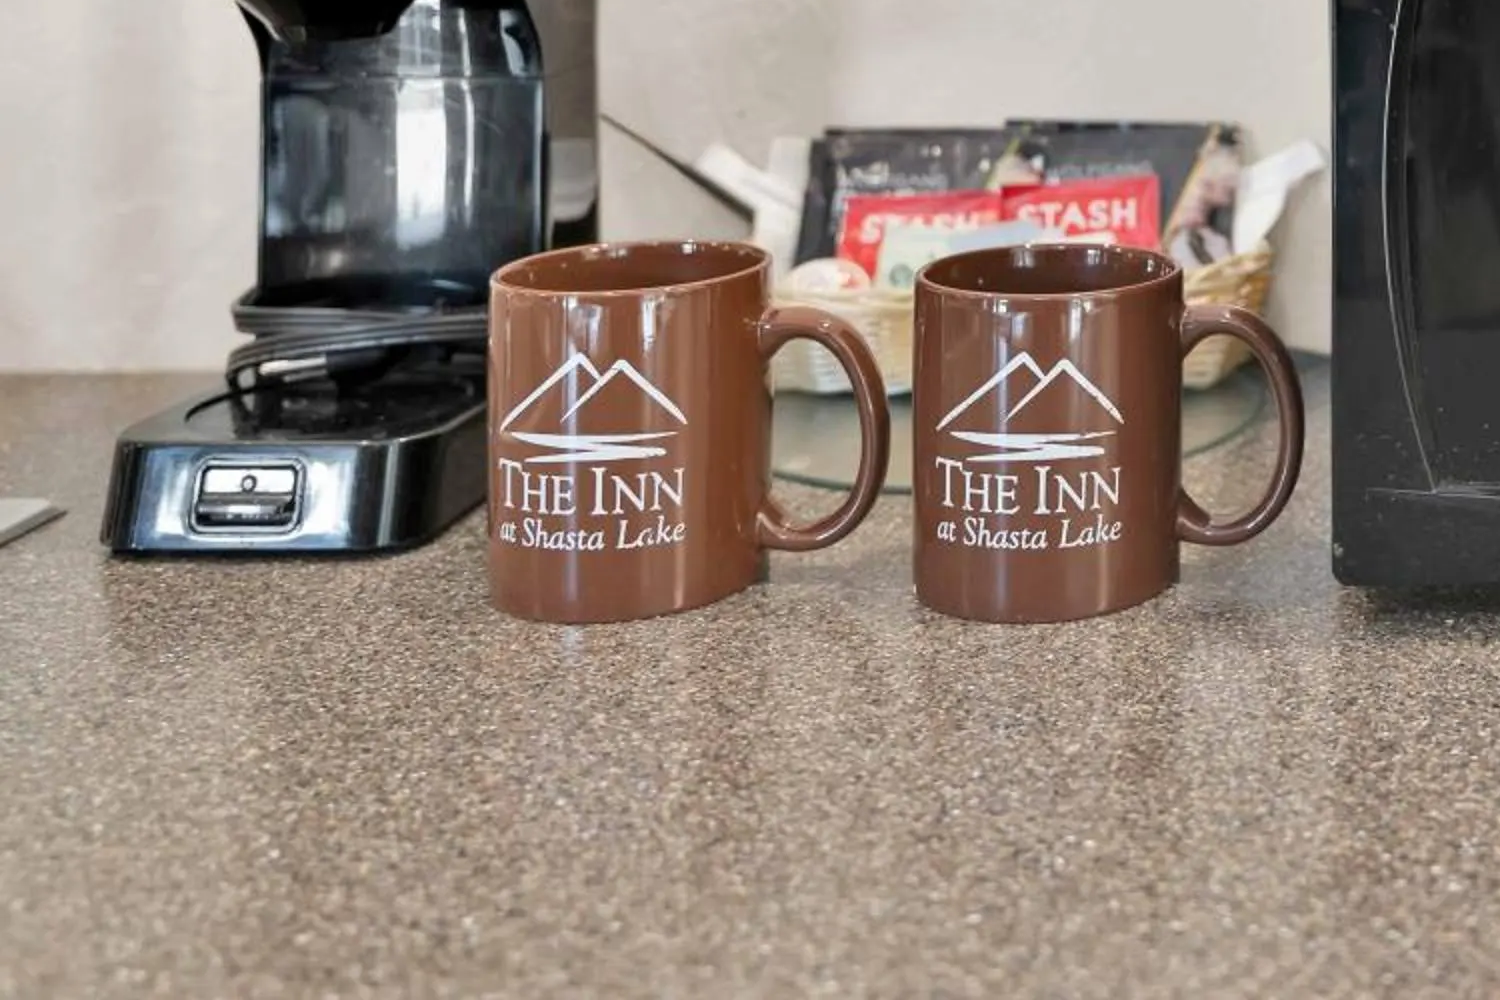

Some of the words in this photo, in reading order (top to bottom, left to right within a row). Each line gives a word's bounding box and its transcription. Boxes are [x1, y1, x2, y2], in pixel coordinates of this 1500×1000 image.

[498, 457, 577, 515] THE
[590, 466, 684, 516] INN
[935, 456, 1021, 515] THE
[1033, 465, 1121, 515] INN
[501, 521, 517, 543] at
[521, 517, 605, 550] Shasta
[616, 515, 686, 549] Lake
[937, 520, 956, 543] at
[963, 516, 1048, 550] Shasta
[1058, 513, 1122, 549] Lake
